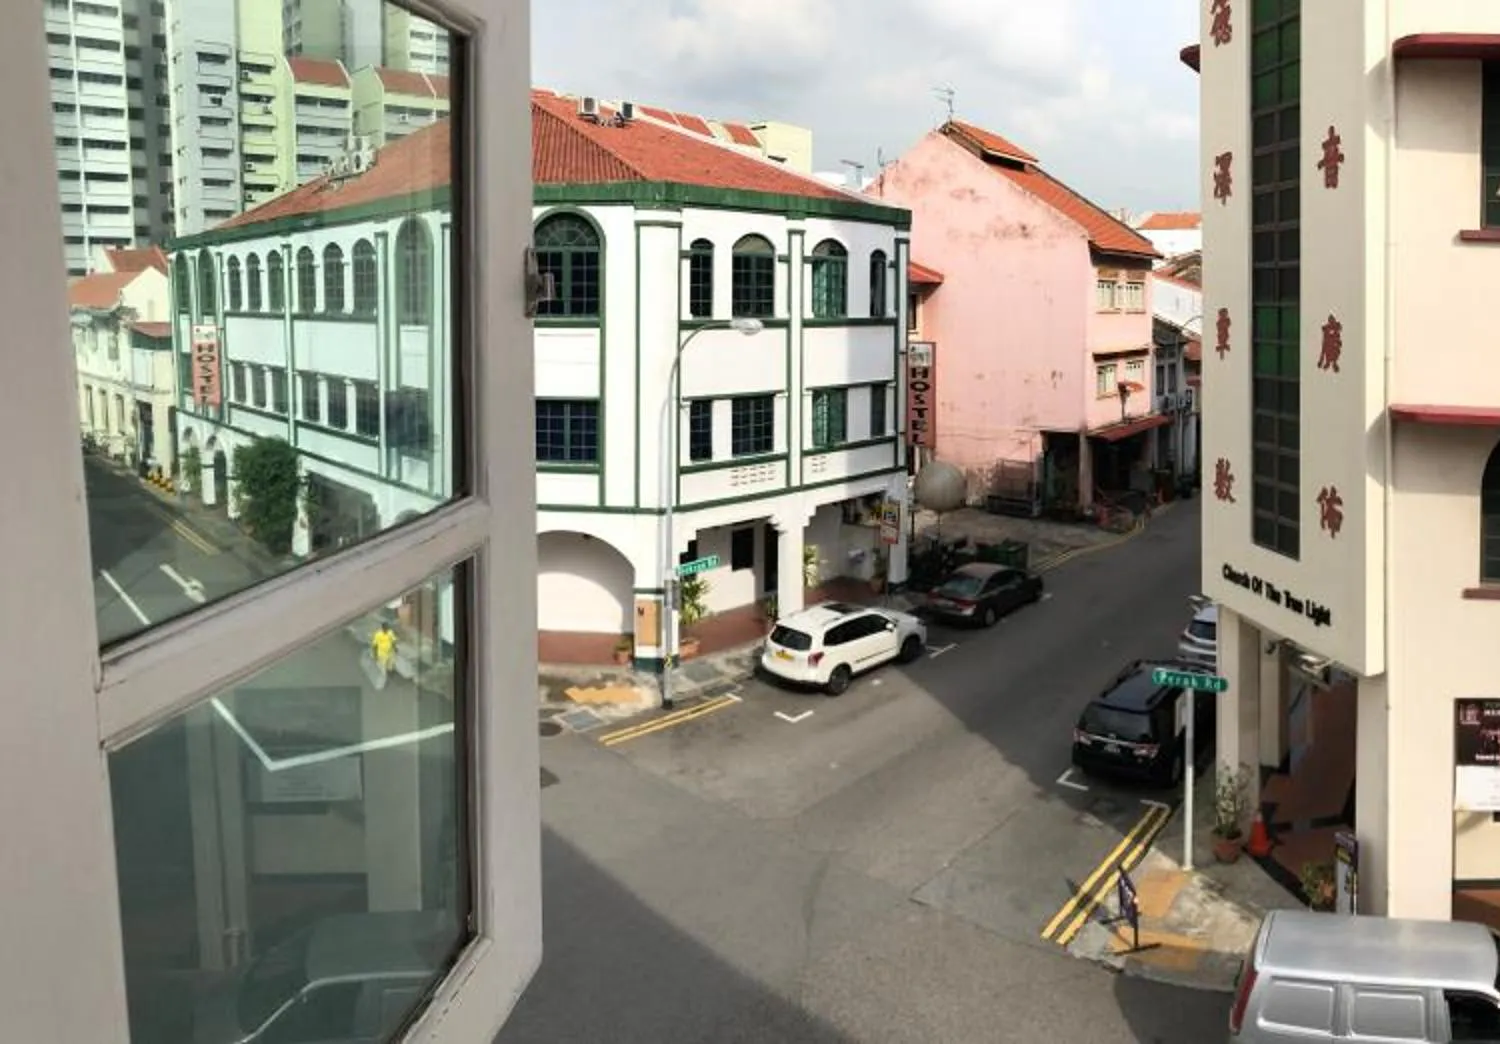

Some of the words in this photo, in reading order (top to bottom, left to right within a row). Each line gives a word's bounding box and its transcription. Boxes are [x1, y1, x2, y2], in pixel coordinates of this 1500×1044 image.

[909, 366, 931, 445] HOSTEL
[1222, 563, 1251, 590] Church
[1251, 576, 1263, 596] Of
[1265, 581, 1282, 605] The
[1284, 590, 1304, 615] True
[1306, 599, 1331, 627] Light
[1160, 671, 1198, 687] Perak
[1205, 677, 1220, 690] Rd
